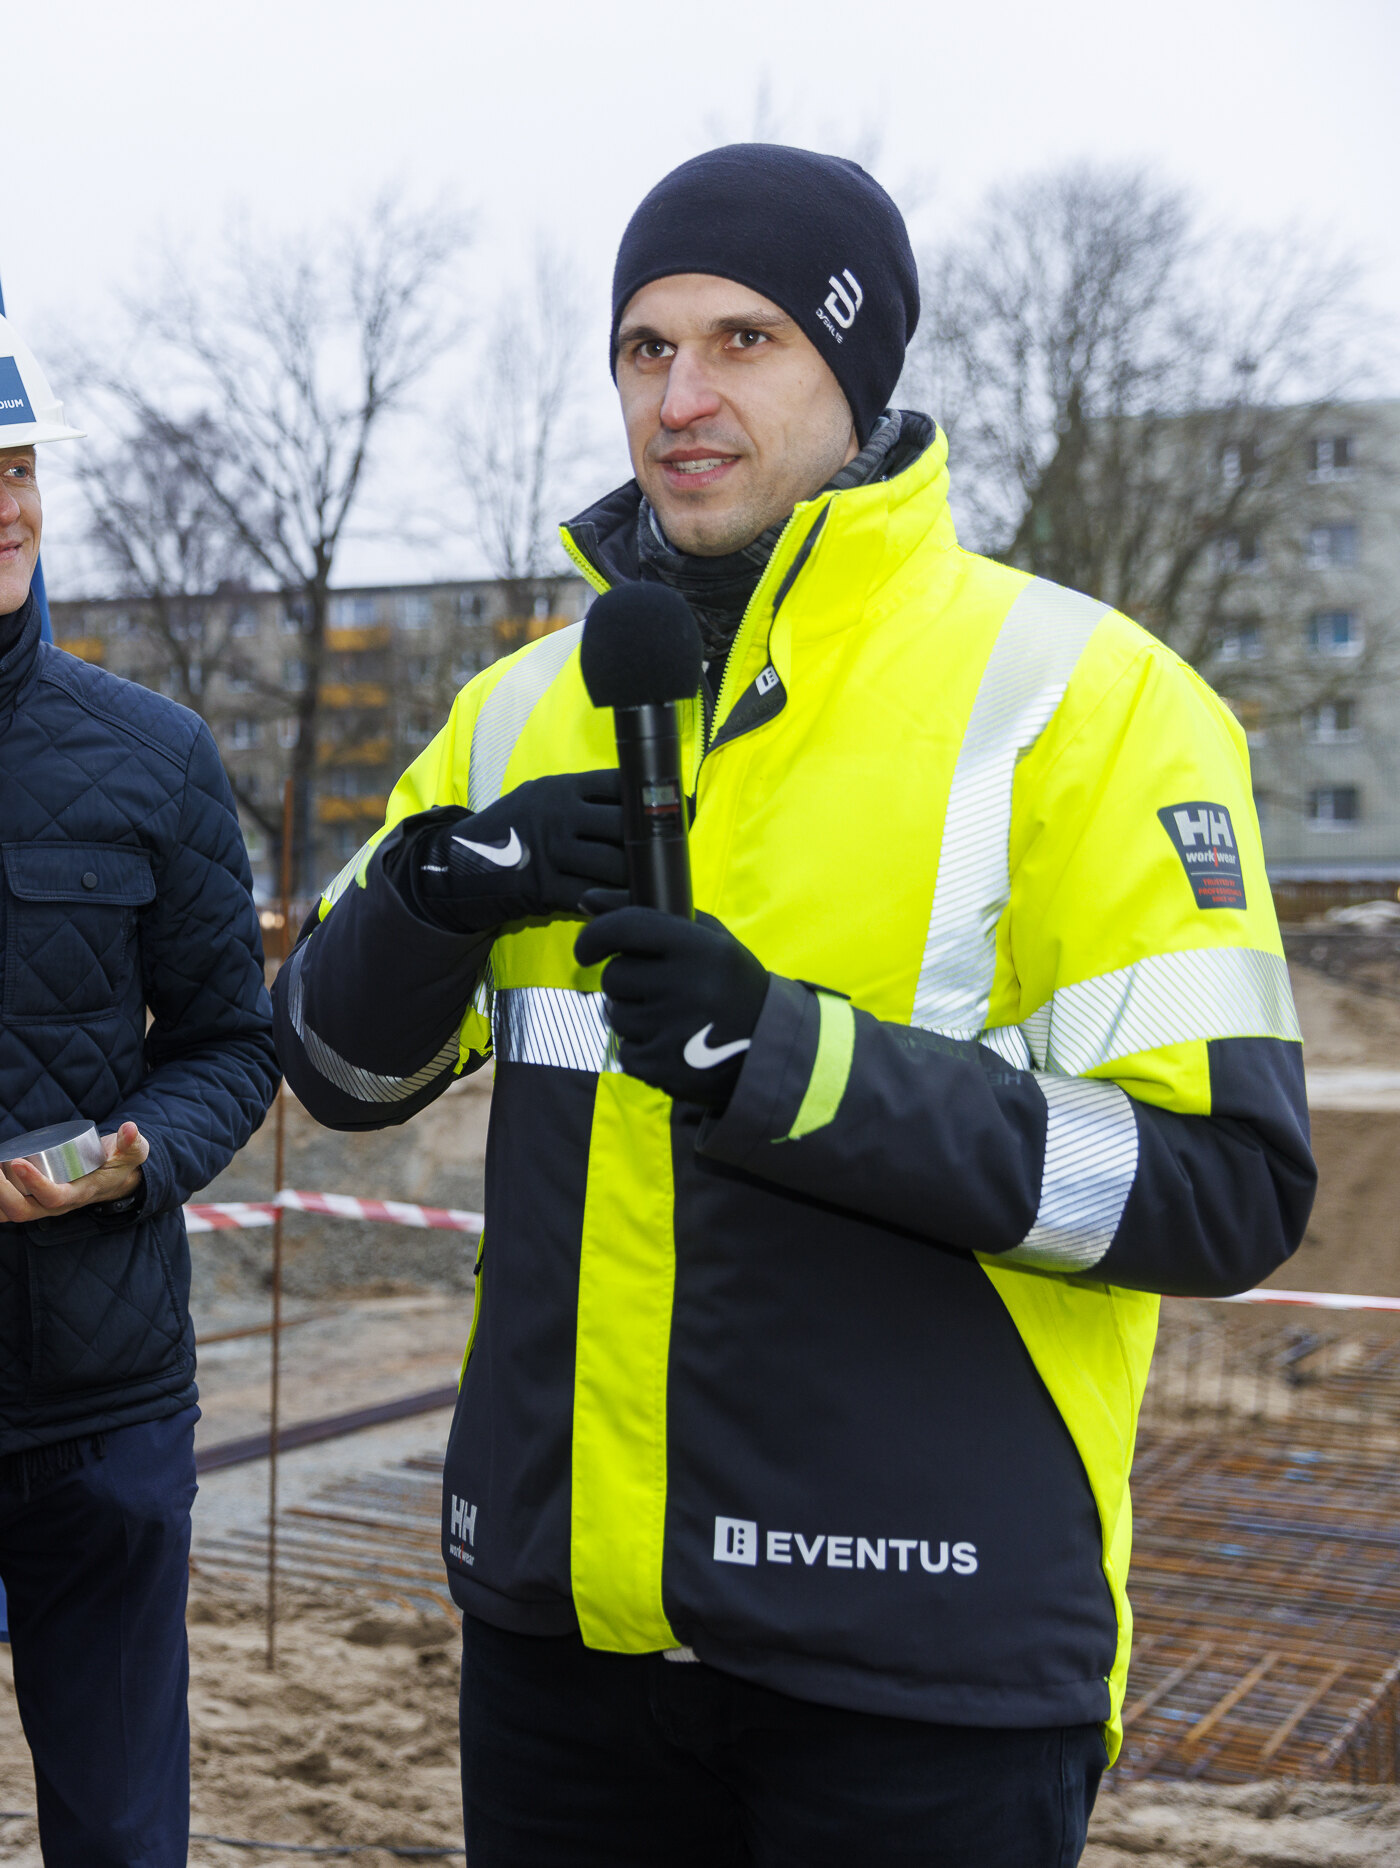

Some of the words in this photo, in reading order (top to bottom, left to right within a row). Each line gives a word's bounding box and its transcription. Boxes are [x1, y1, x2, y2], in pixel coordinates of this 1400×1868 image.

[1173, 809, 1233, 848] HH
[450, 1494, 478, 1547] HH
[766, 1531, 979, 1575] EVENTUS
